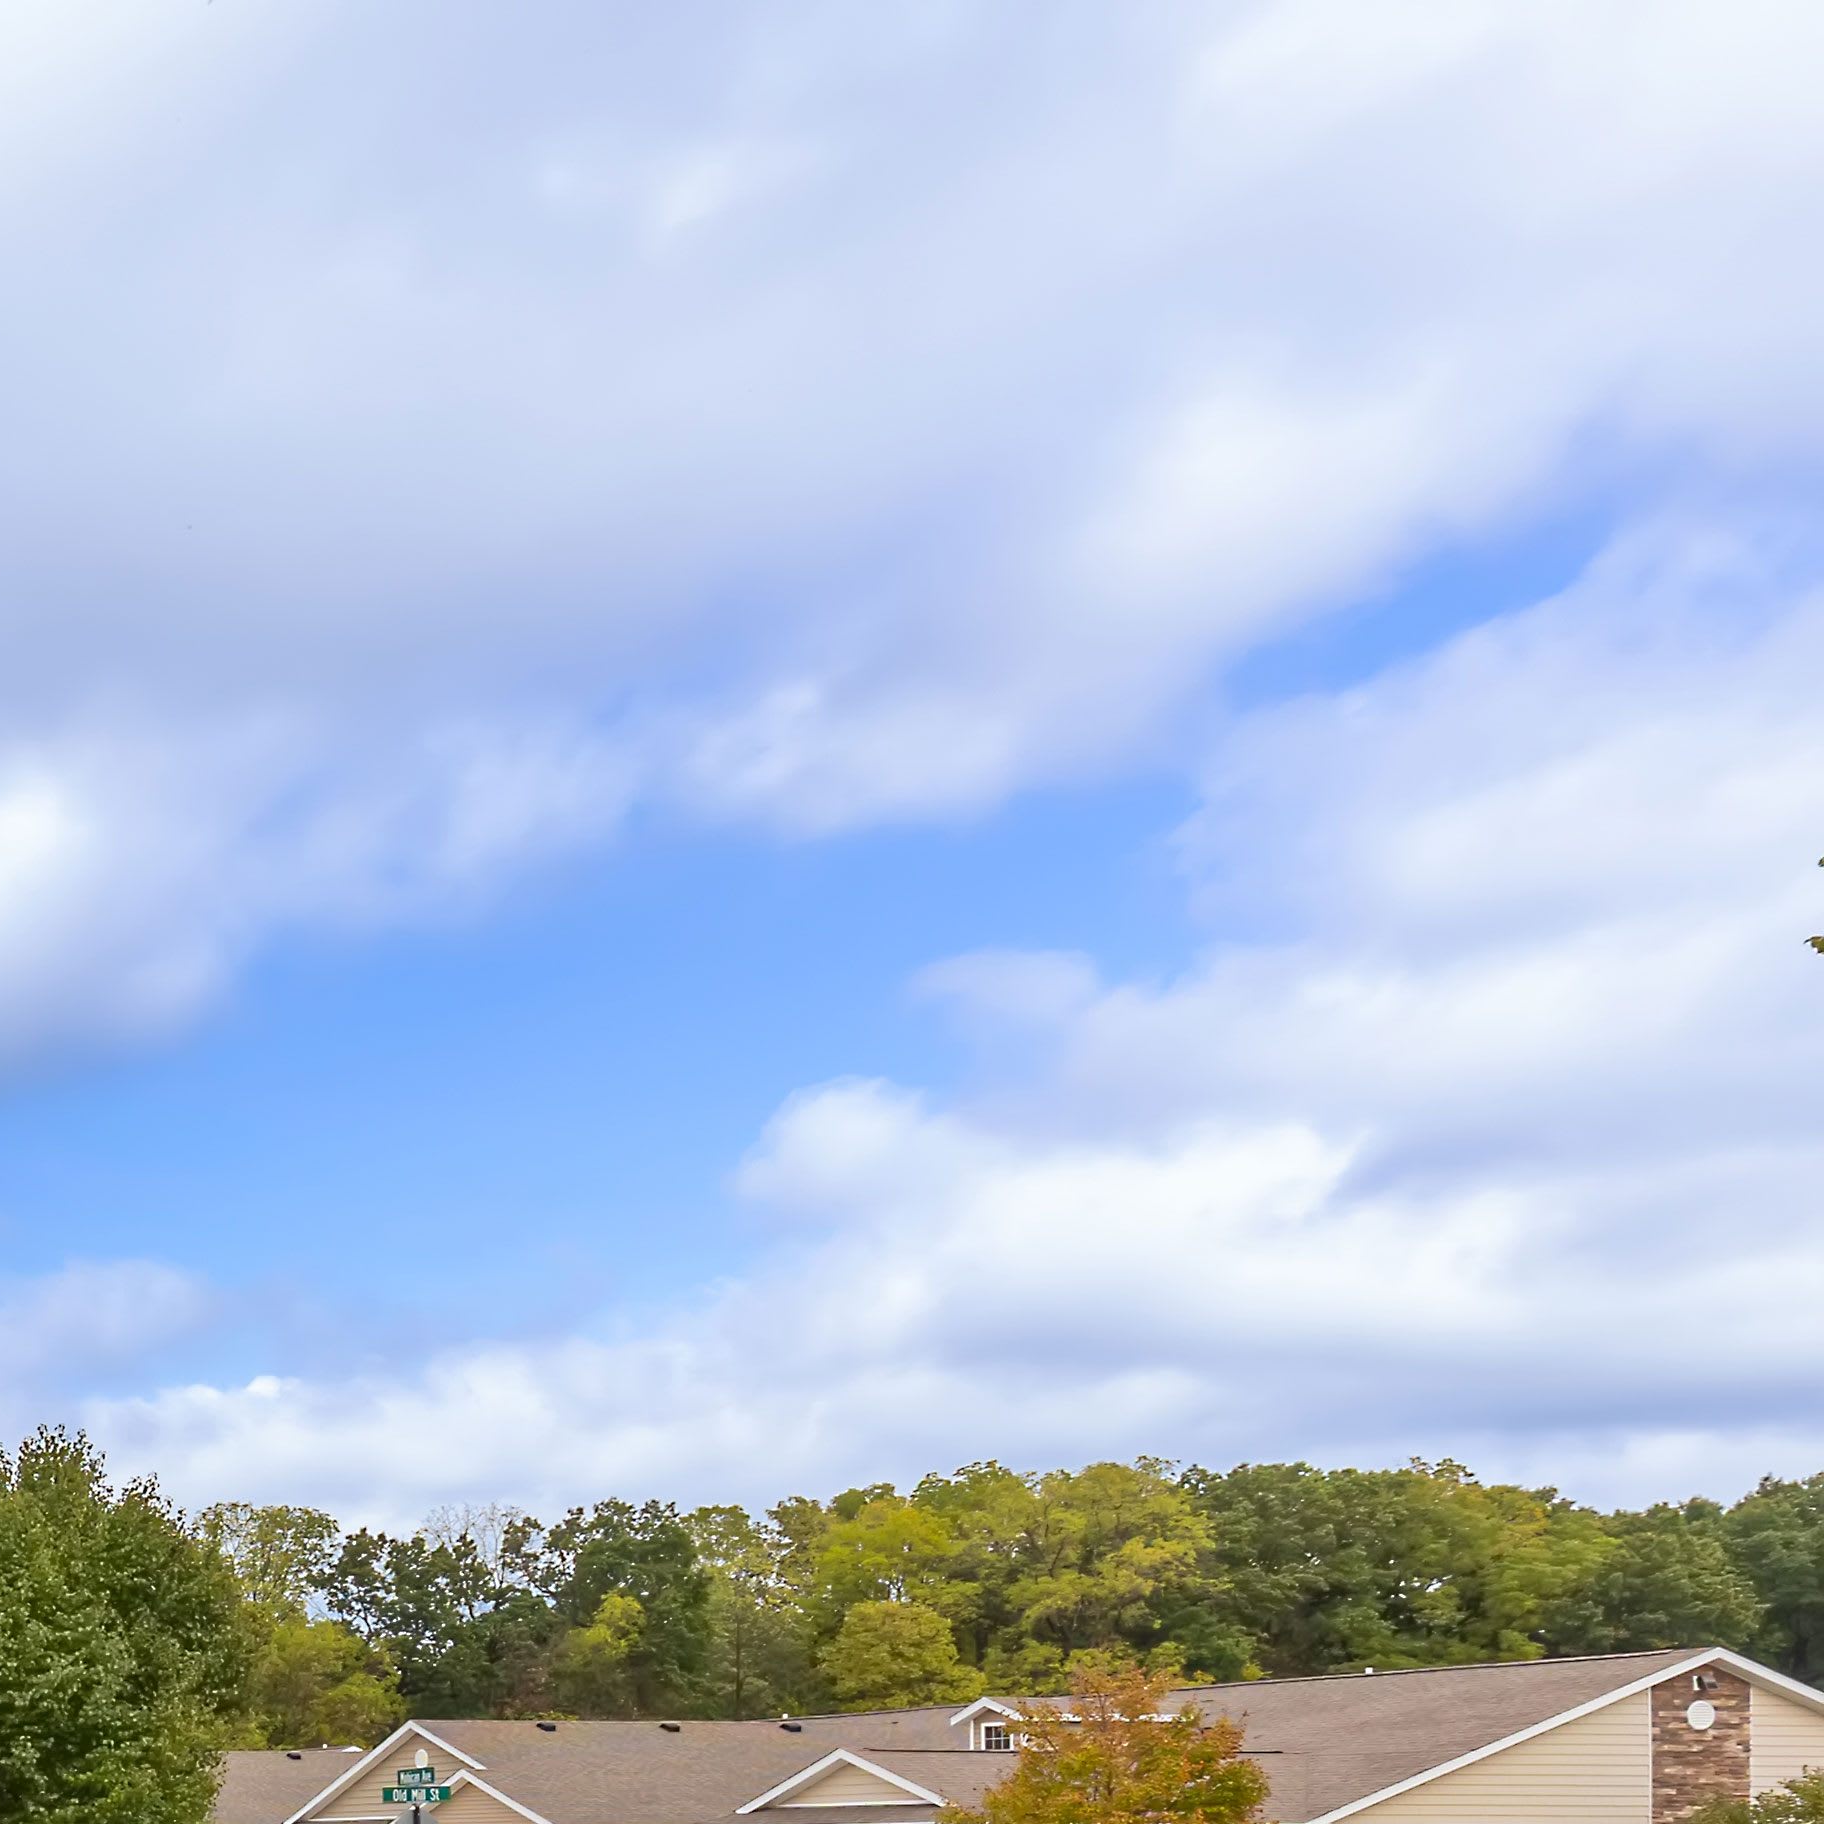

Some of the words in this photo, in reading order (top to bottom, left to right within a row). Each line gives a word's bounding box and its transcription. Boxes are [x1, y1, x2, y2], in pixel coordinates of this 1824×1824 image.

[393, 1789, 407, 1802] Old
[411, 1788, 426, 1802] Mill
[430, 1788, 440, 1801] St
